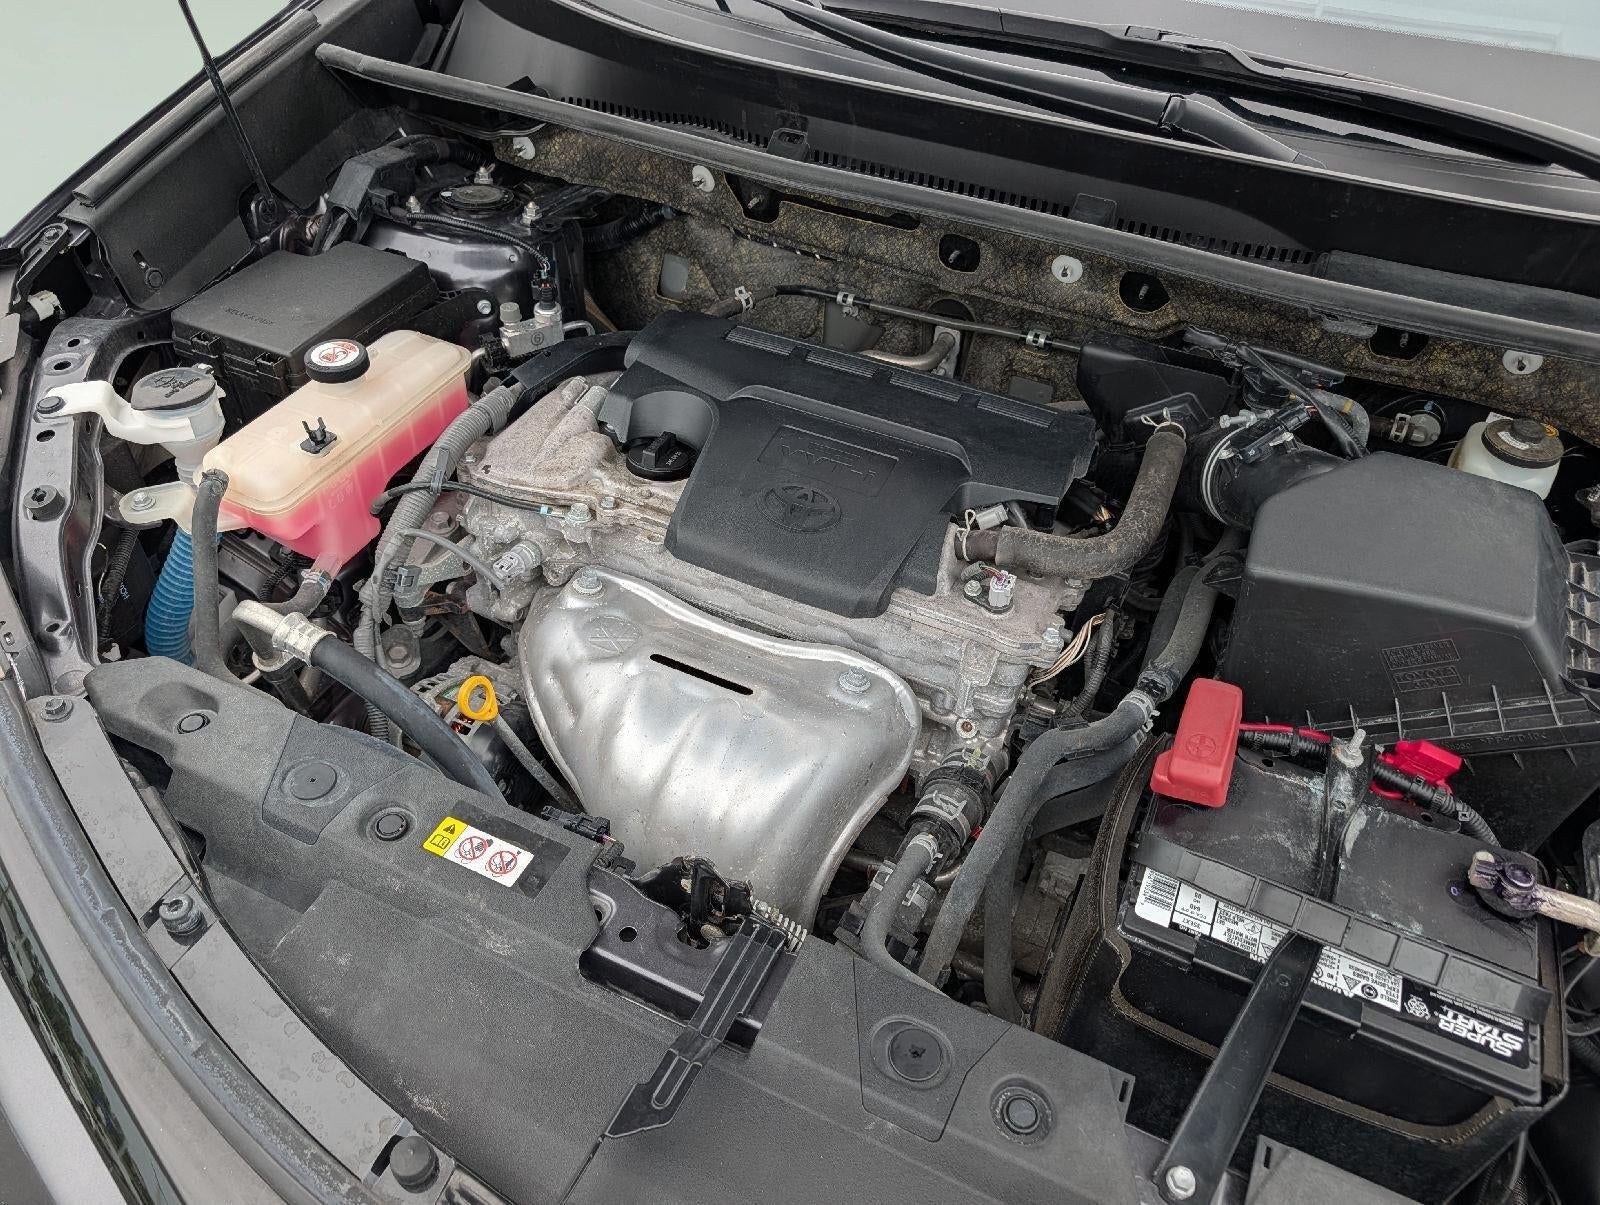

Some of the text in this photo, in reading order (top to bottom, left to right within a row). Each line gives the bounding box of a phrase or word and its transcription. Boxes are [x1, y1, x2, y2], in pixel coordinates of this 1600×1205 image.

[1244, 933, 1258, 943] WITH
[1326, 972, 1335, 980] NO
[1371, 978, 1400, 994] EXPLOSIVE
[1380, 993, 1399, 1006] SHIELD
[1438, 1010, 1525, 1052] START
[1438, 1018, 1515, 1058] SUPER
